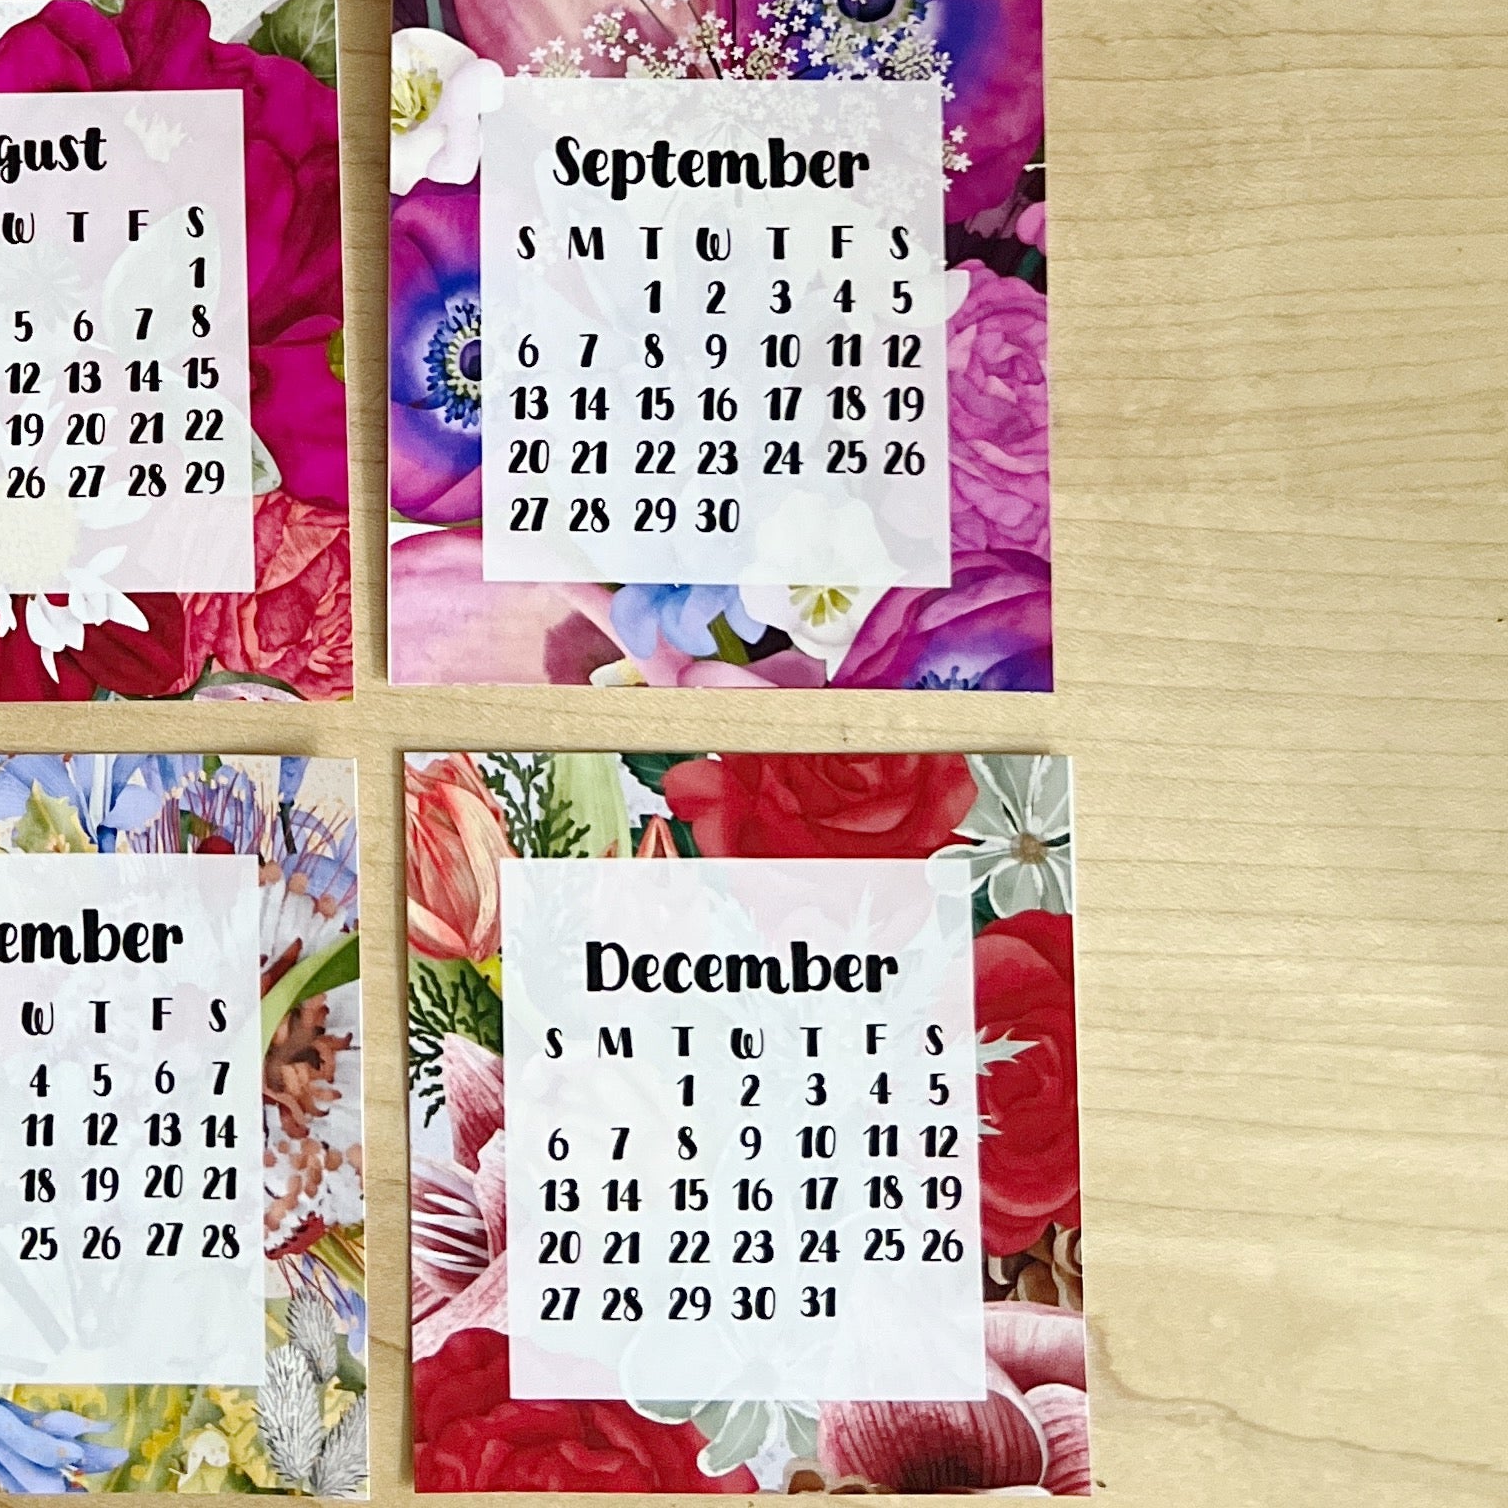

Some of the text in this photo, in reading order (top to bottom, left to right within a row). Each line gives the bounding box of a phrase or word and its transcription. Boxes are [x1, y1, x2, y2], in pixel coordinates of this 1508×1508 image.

[552, 135, 870, 201] September
[1, 212, 35, 245] W
[66, 211, 90, 243] T
[128, 209, 150, 242] F
[186, 206, 205, 238] S
[516, 225, 909, 262] S M T W T F S
[509, 497, 740, 534] 27 28 29 30
[585, 940, 899, 995] December
[21, 1001, 54, 1036] W
[88, 1000, 111, 1034] T
[152, 997, 173, 1031] F
[208, 998, 227, 1033] S
[545, 1023, 944, 1060] S M T W T F S
[540, 1286, 836, 1322] 27 28 29 30 31
